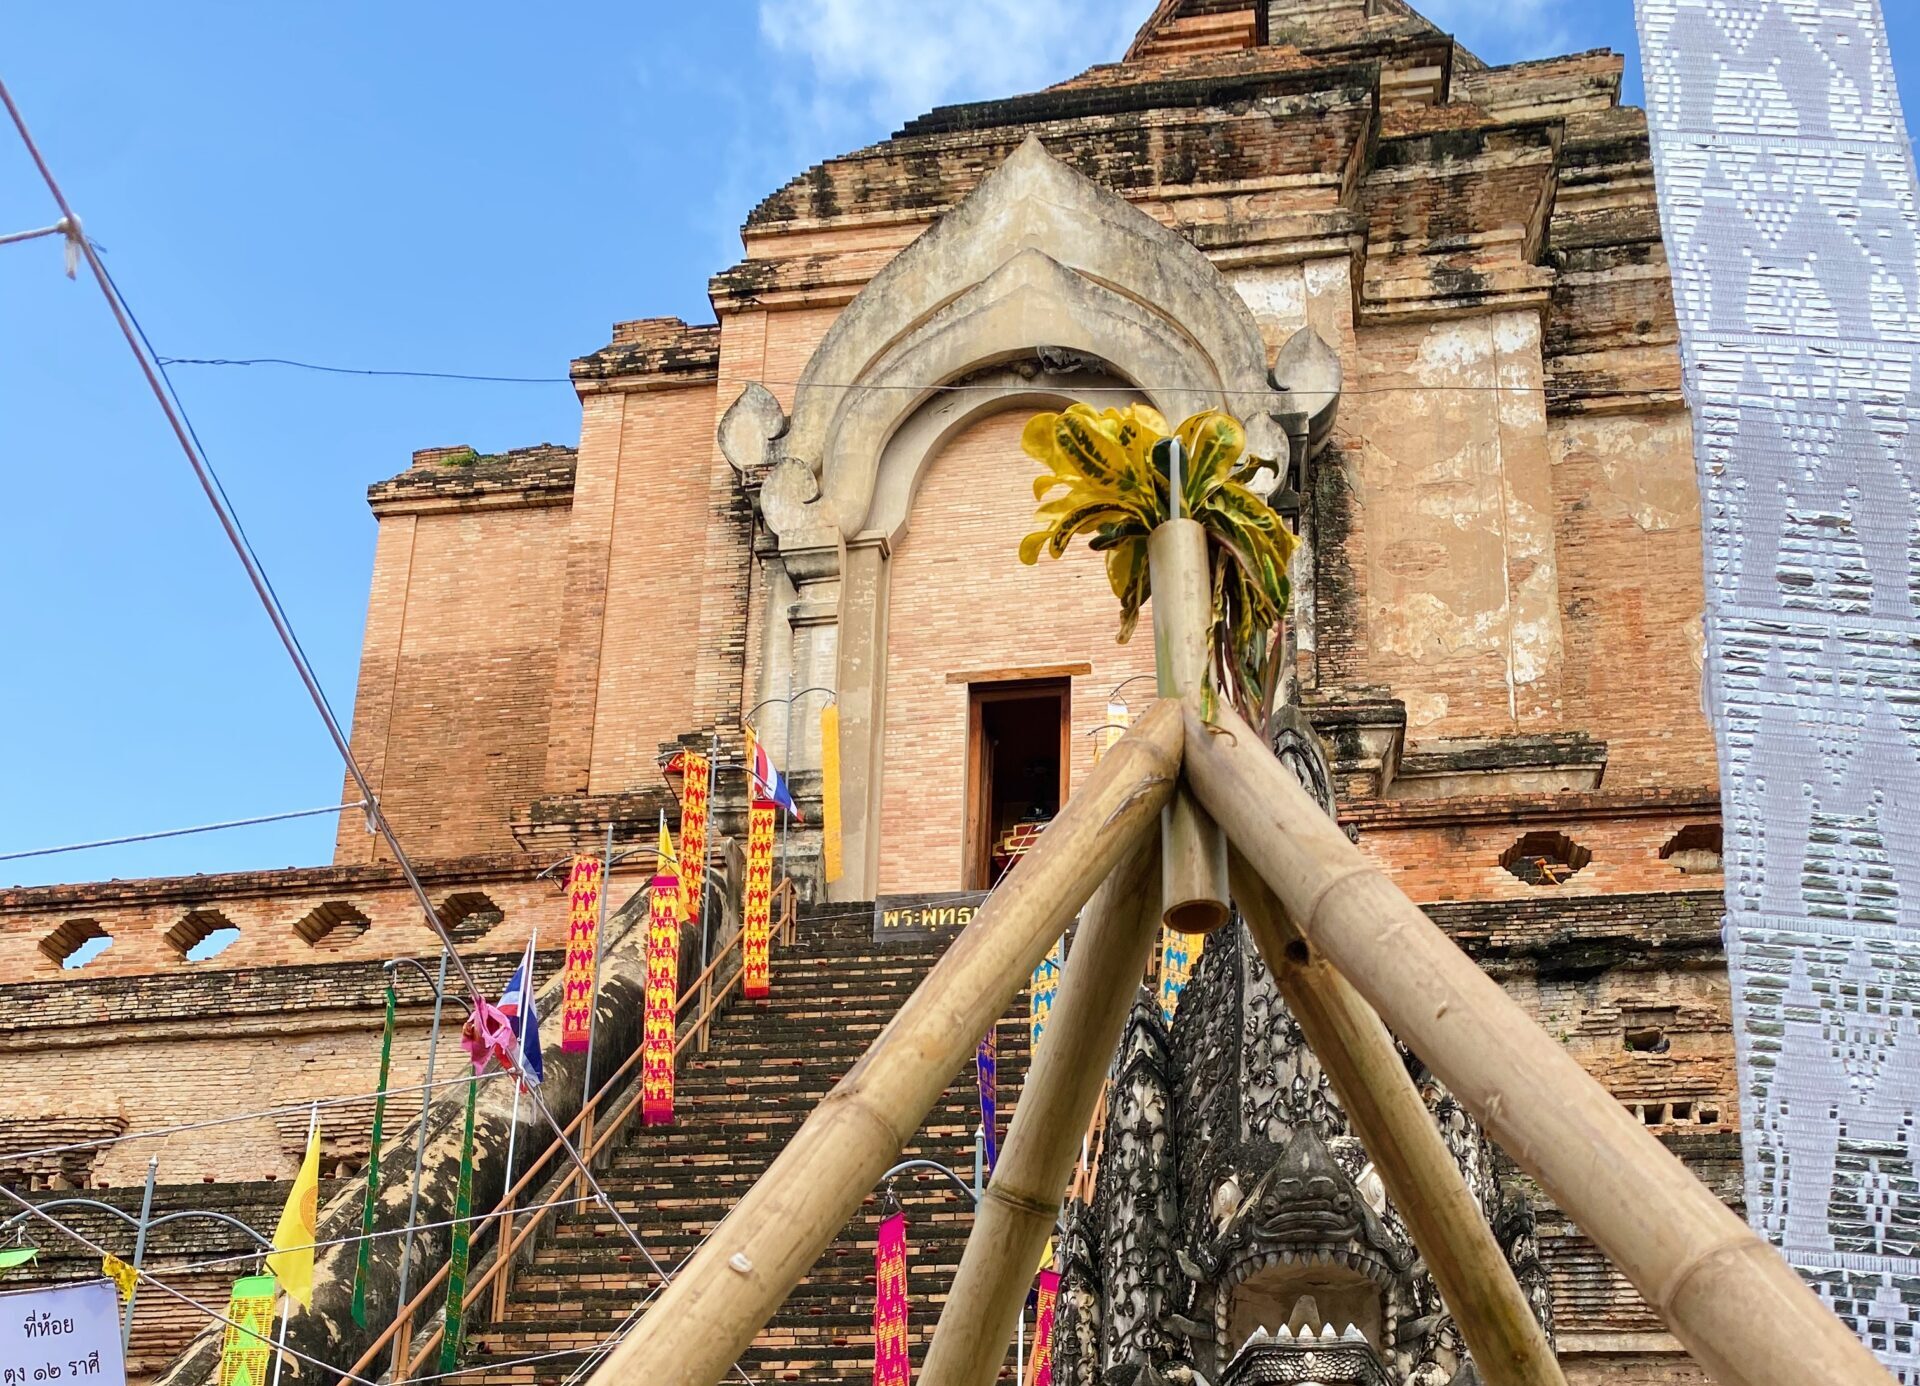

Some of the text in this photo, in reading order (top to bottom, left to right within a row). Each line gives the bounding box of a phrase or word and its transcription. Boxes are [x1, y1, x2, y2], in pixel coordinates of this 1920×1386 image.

[23, 1309, 74, 1338] ที่ห้อย
[33, 1362, 62, 1381] ๑๒
[68, 1349, 100, 1376] ราศี
